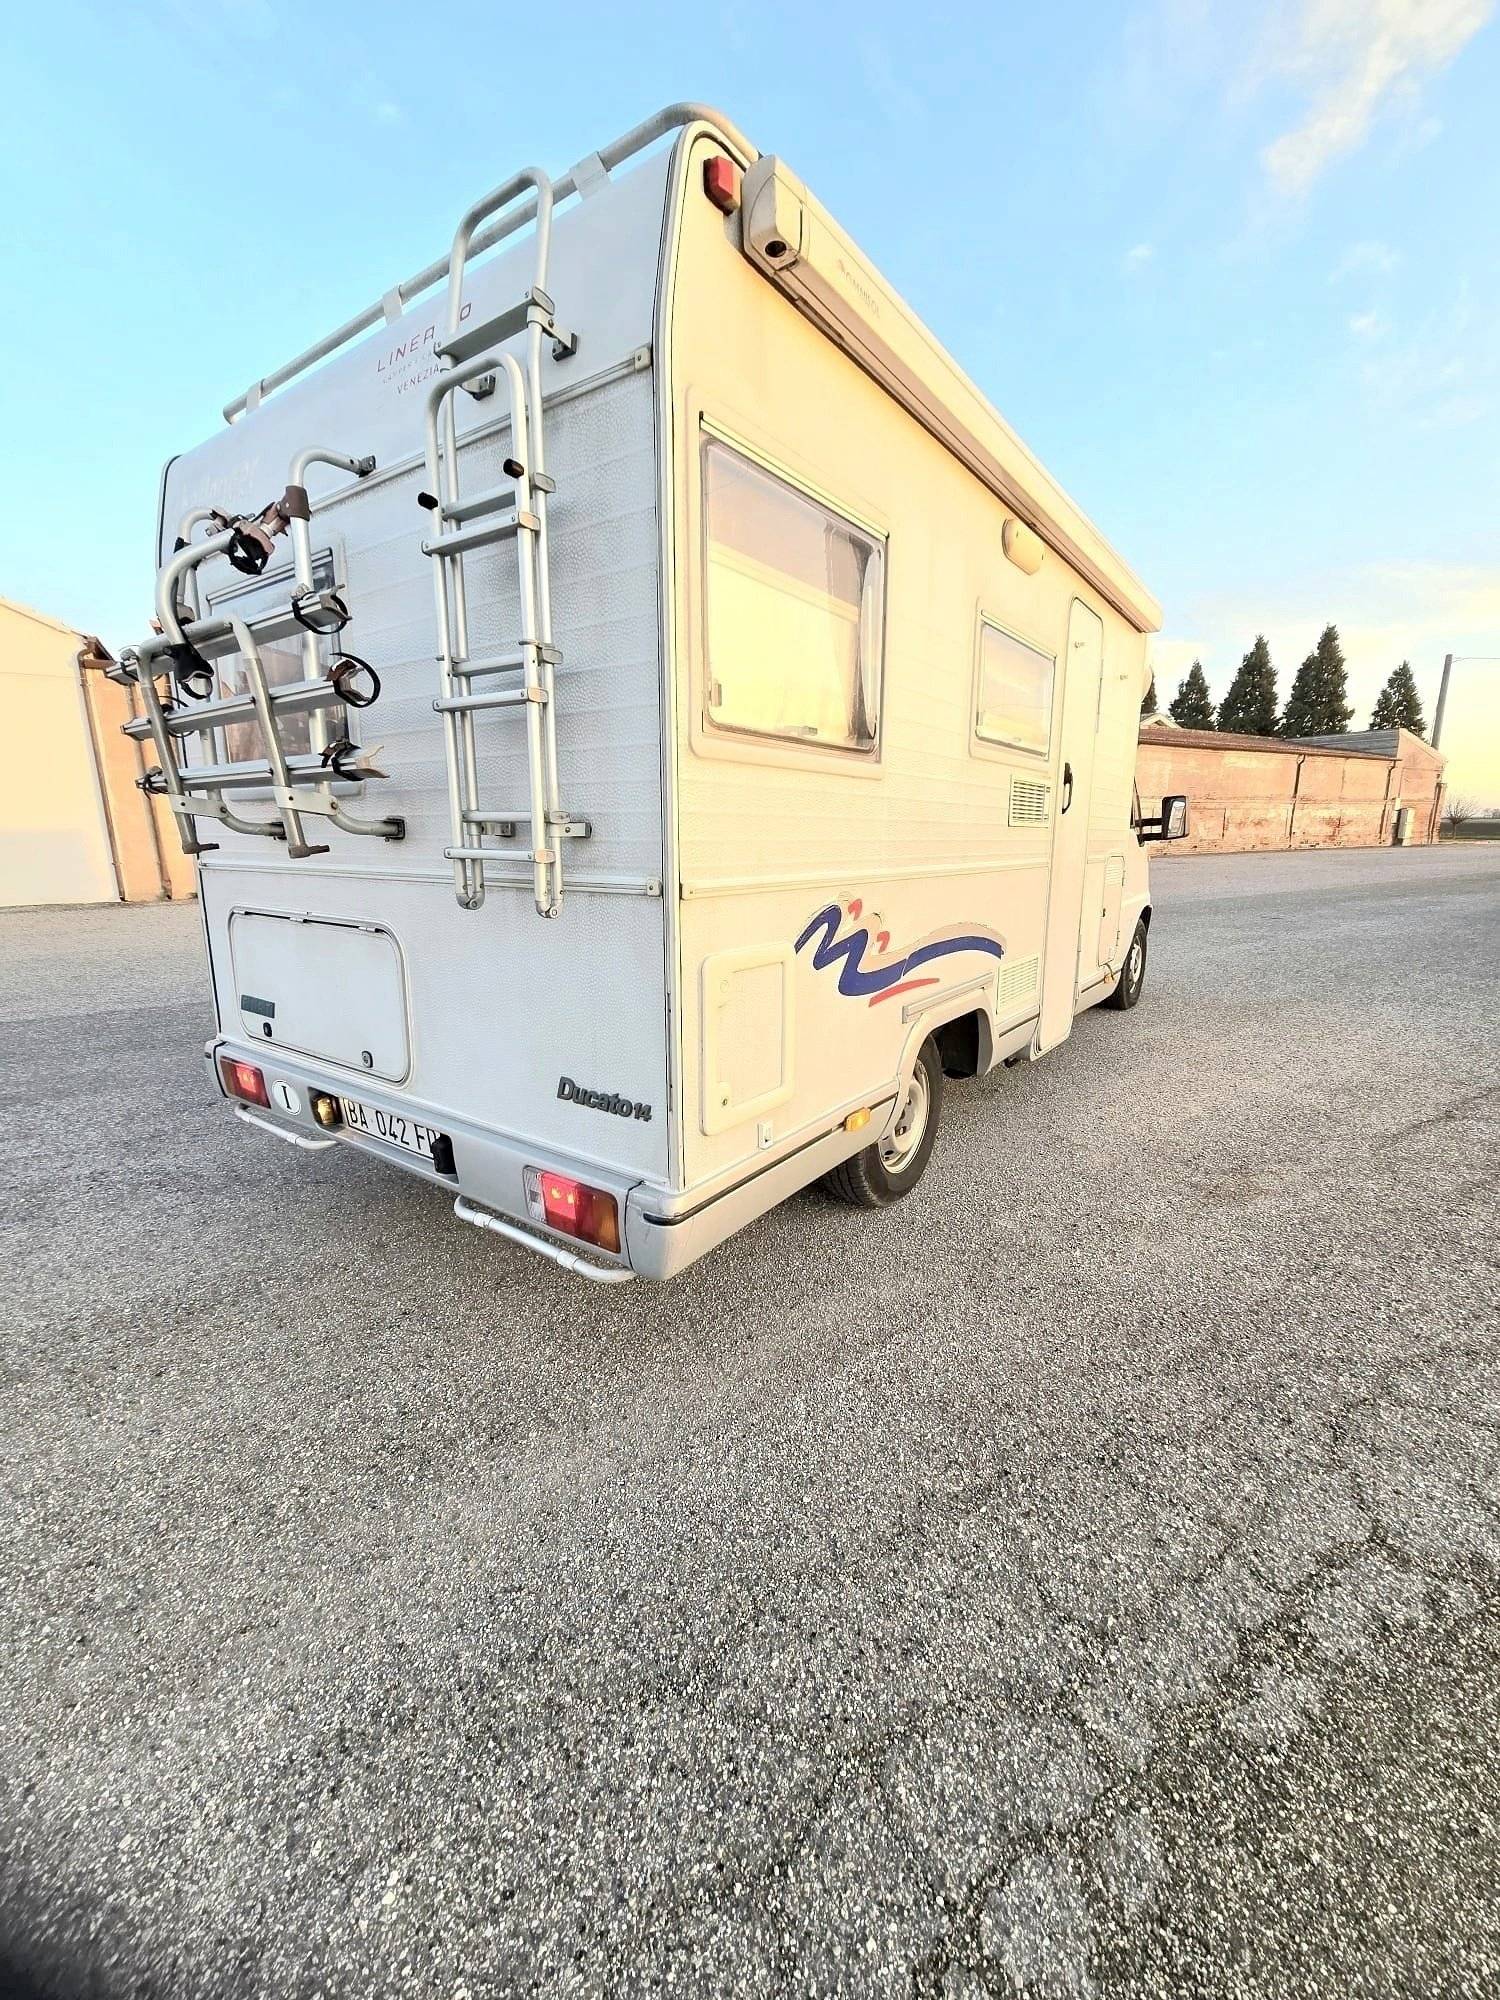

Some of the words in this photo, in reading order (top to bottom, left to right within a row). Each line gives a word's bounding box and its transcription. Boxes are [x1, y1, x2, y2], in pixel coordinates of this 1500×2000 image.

[377, 325, 435, 372] LINEA
[397, 363, 439, 394] VENEZIA
[281, 1085, 292, 1110] I
[557, 1076, 633, 1117] Ducato
[634, 1102, 652, 1122] 14
[348, 1099, 369, 1129] BA
[375, 1110, 410, 1146] 042
